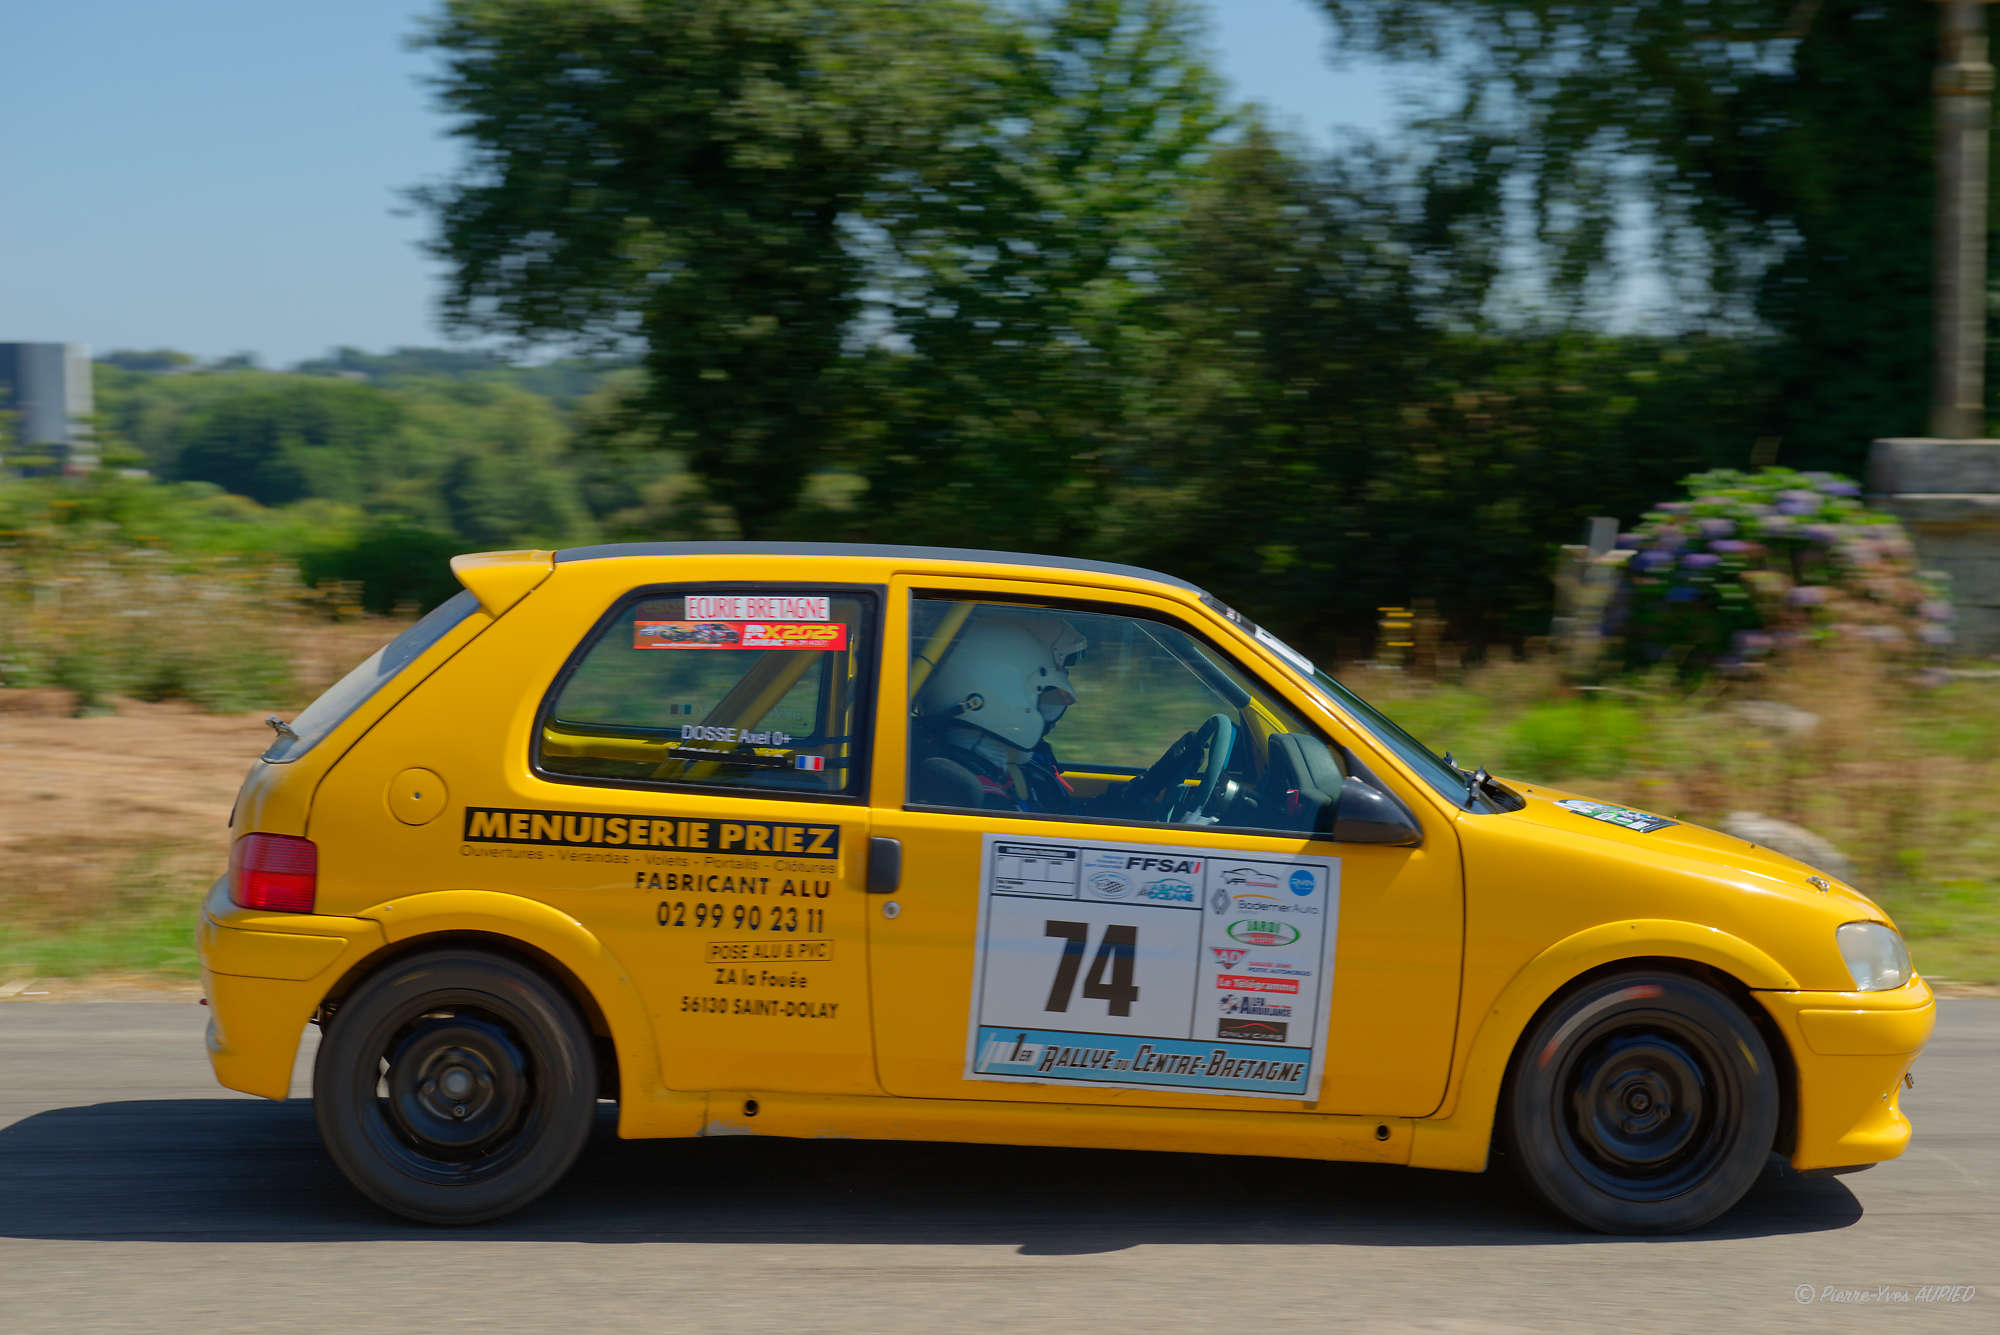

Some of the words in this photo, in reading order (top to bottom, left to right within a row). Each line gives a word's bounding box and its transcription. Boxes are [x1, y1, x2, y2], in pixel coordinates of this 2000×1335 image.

[688, 597, 742, 618] ECURIE
[747, 598, 826, 619] BRETAGNE
[681, 724, 737, 742] DOSSE
[738, 729, 770, 745] Axel
[469, 811, 709, 848] MENUISERIE
[719, 823, 834, 854] PRIEZ
[459, 844, 543, 861] Ouvertures
[643, 853, 688, 868] Volets
[1125, 856, 1191, 874] FFSA
[635, 871, 769, 896] FABRICANT
[780, 879, 830, 899] ALU
[658, 901, 686, 928] 02
[695, 904, 723, 929] 99
[733, 906, 762, 931] 90
[770, 907, 798, 933] 23
[807, 909, 824, 934] 11
[712, 945, 749, 960] POSE
[754, 945, 781, 959] ALU
[800, 942, 826, 958] PVC
[715, 968, 737, 986] ZA
[742, 970, 757, 987] la
[761, 970, 808, 989] Fouée
[1044, 919, 1140, 1017] 74
[1218, 977, 1234, 988] Le
[681, 996, 728, 1014] 56130
[733, 999, 839, 1019] SAINT-DOLAY
[1037, 1044, 1116, 1073] RALLYE
[1132, 1043, 1306, 1082] CENTRE-BRETAGNE
